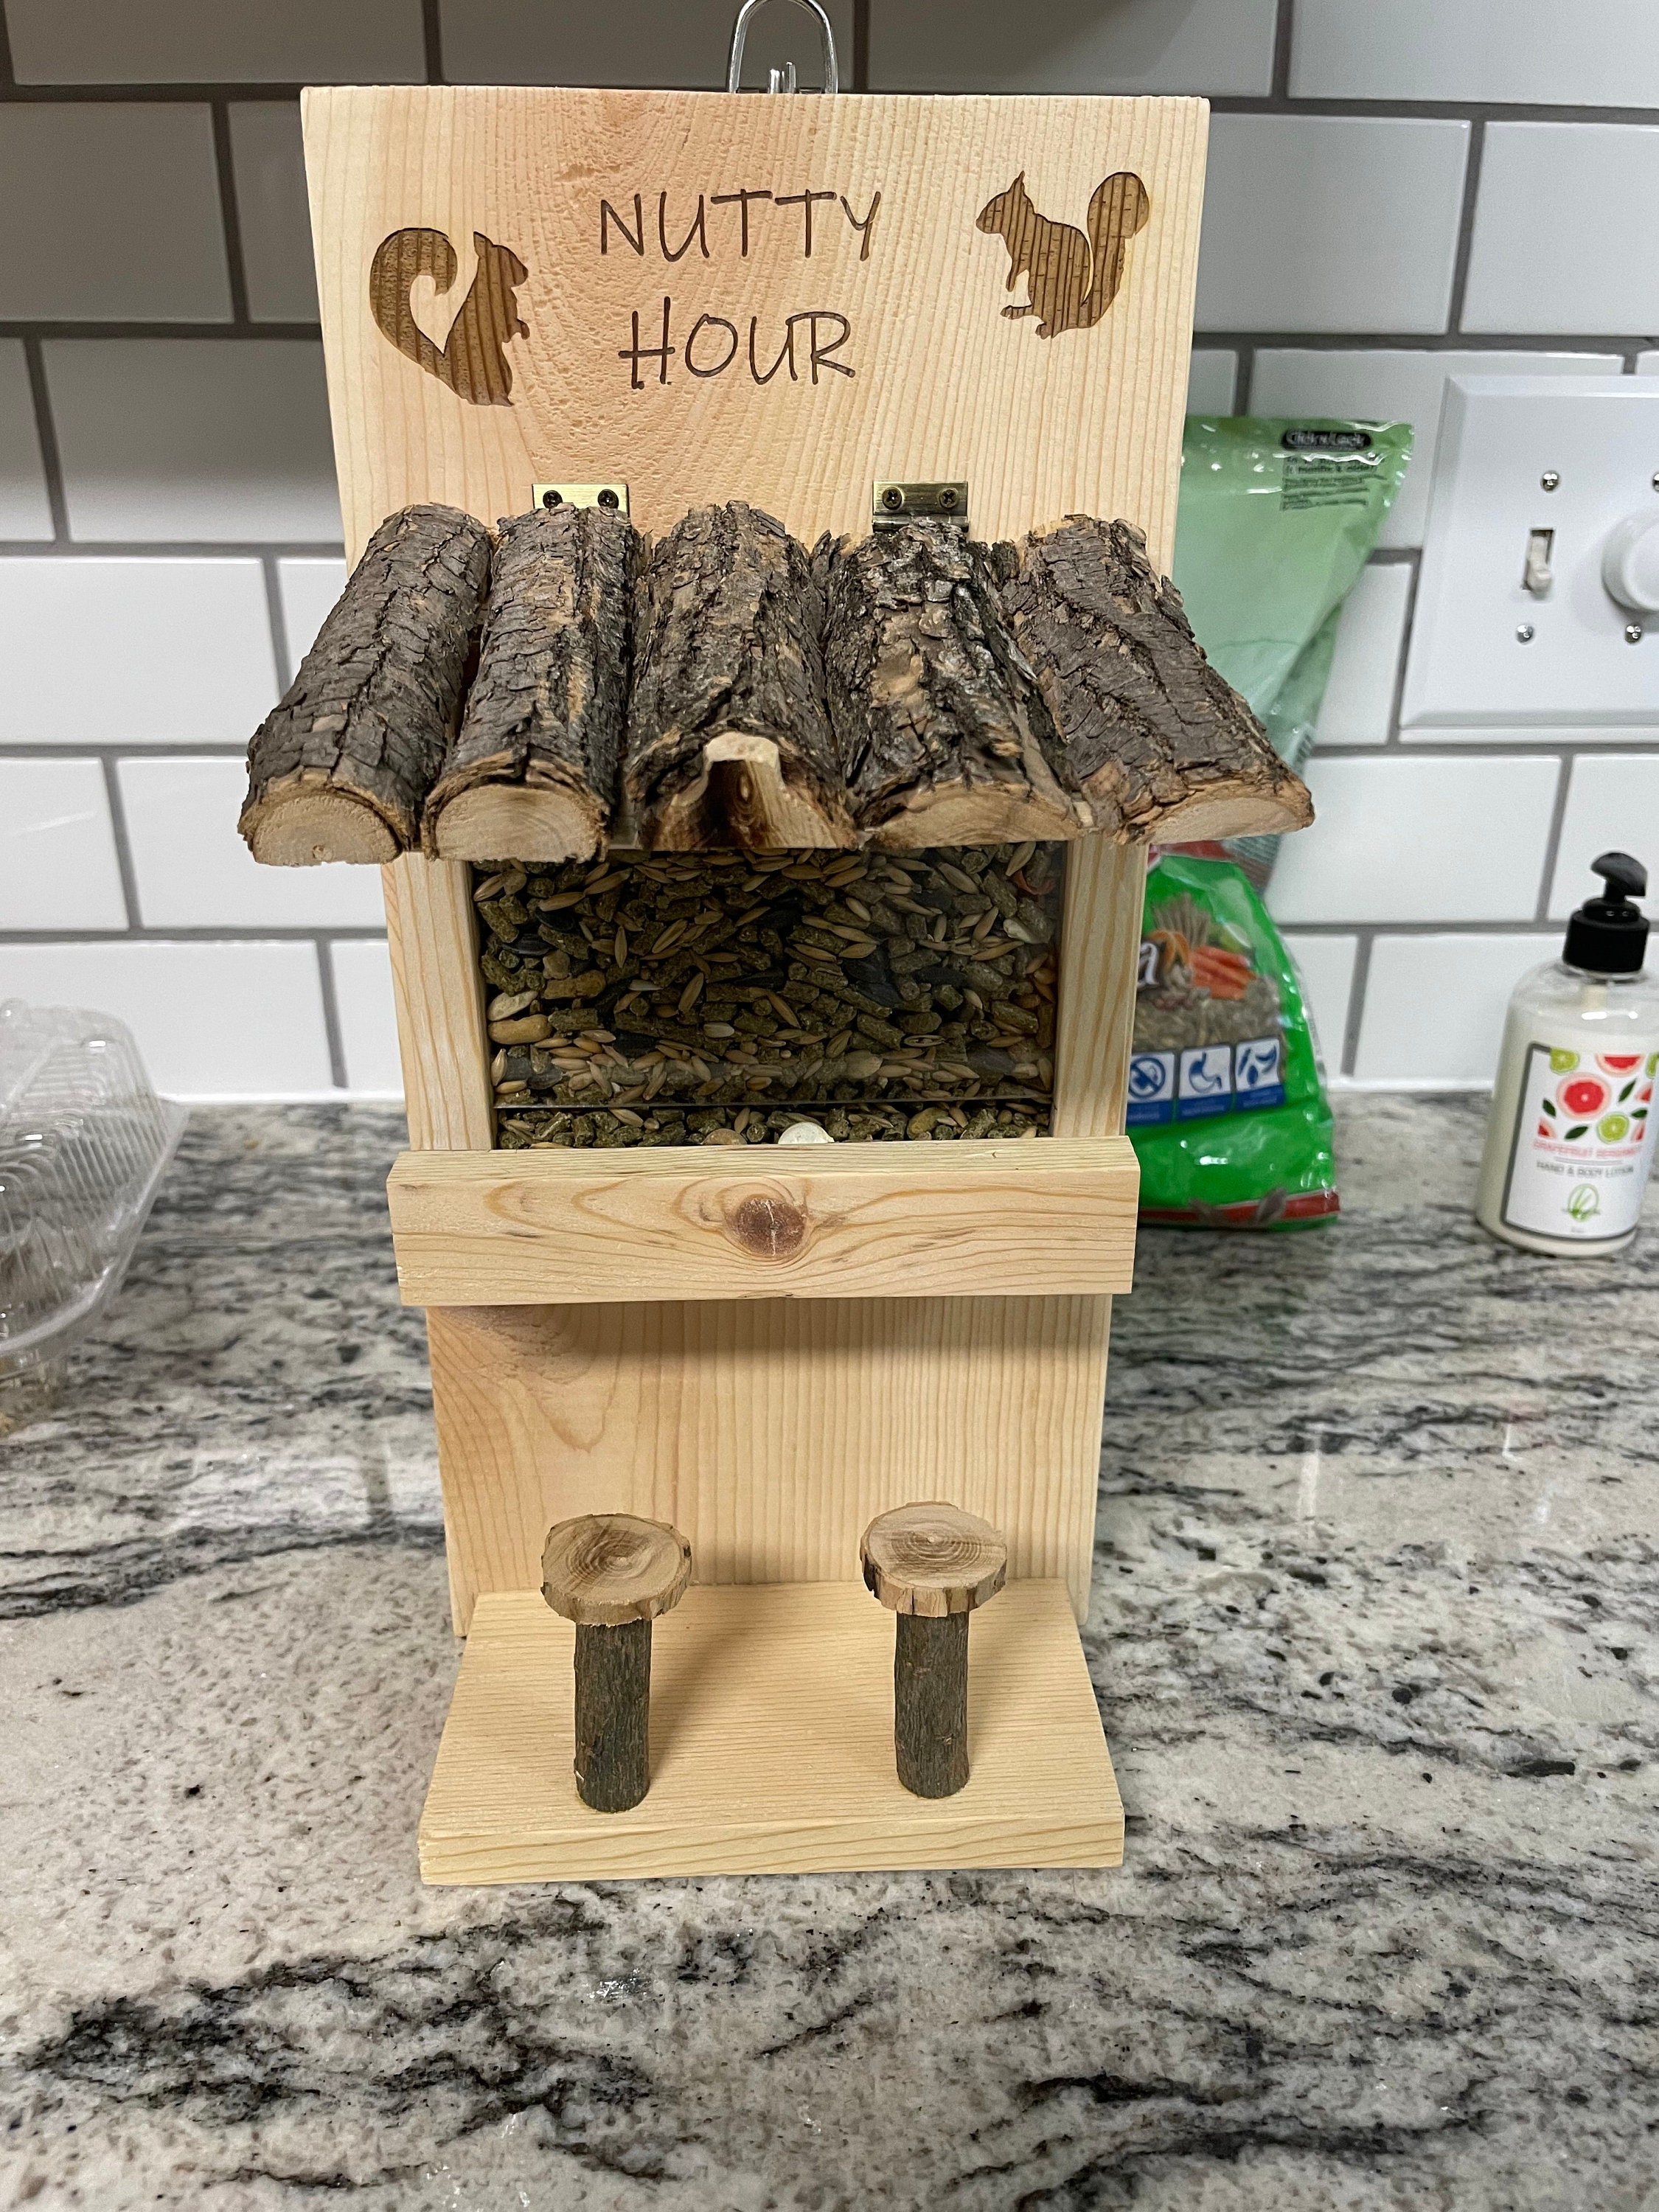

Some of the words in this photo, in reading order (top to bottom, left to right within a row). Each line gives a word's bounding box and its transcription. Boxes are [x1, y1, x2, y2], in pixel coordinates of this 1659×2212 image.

[600, 189, 881, 262] NUTTY
[618, 296, 856, 389] HOUR
[1537, 1160, 1565, 1175] HAND
[1568, 1166, 1575, 1177] &
[1577, 1166, 1603, 1178] BODY
[1604, 1165, 1634, 1178] LOTION
